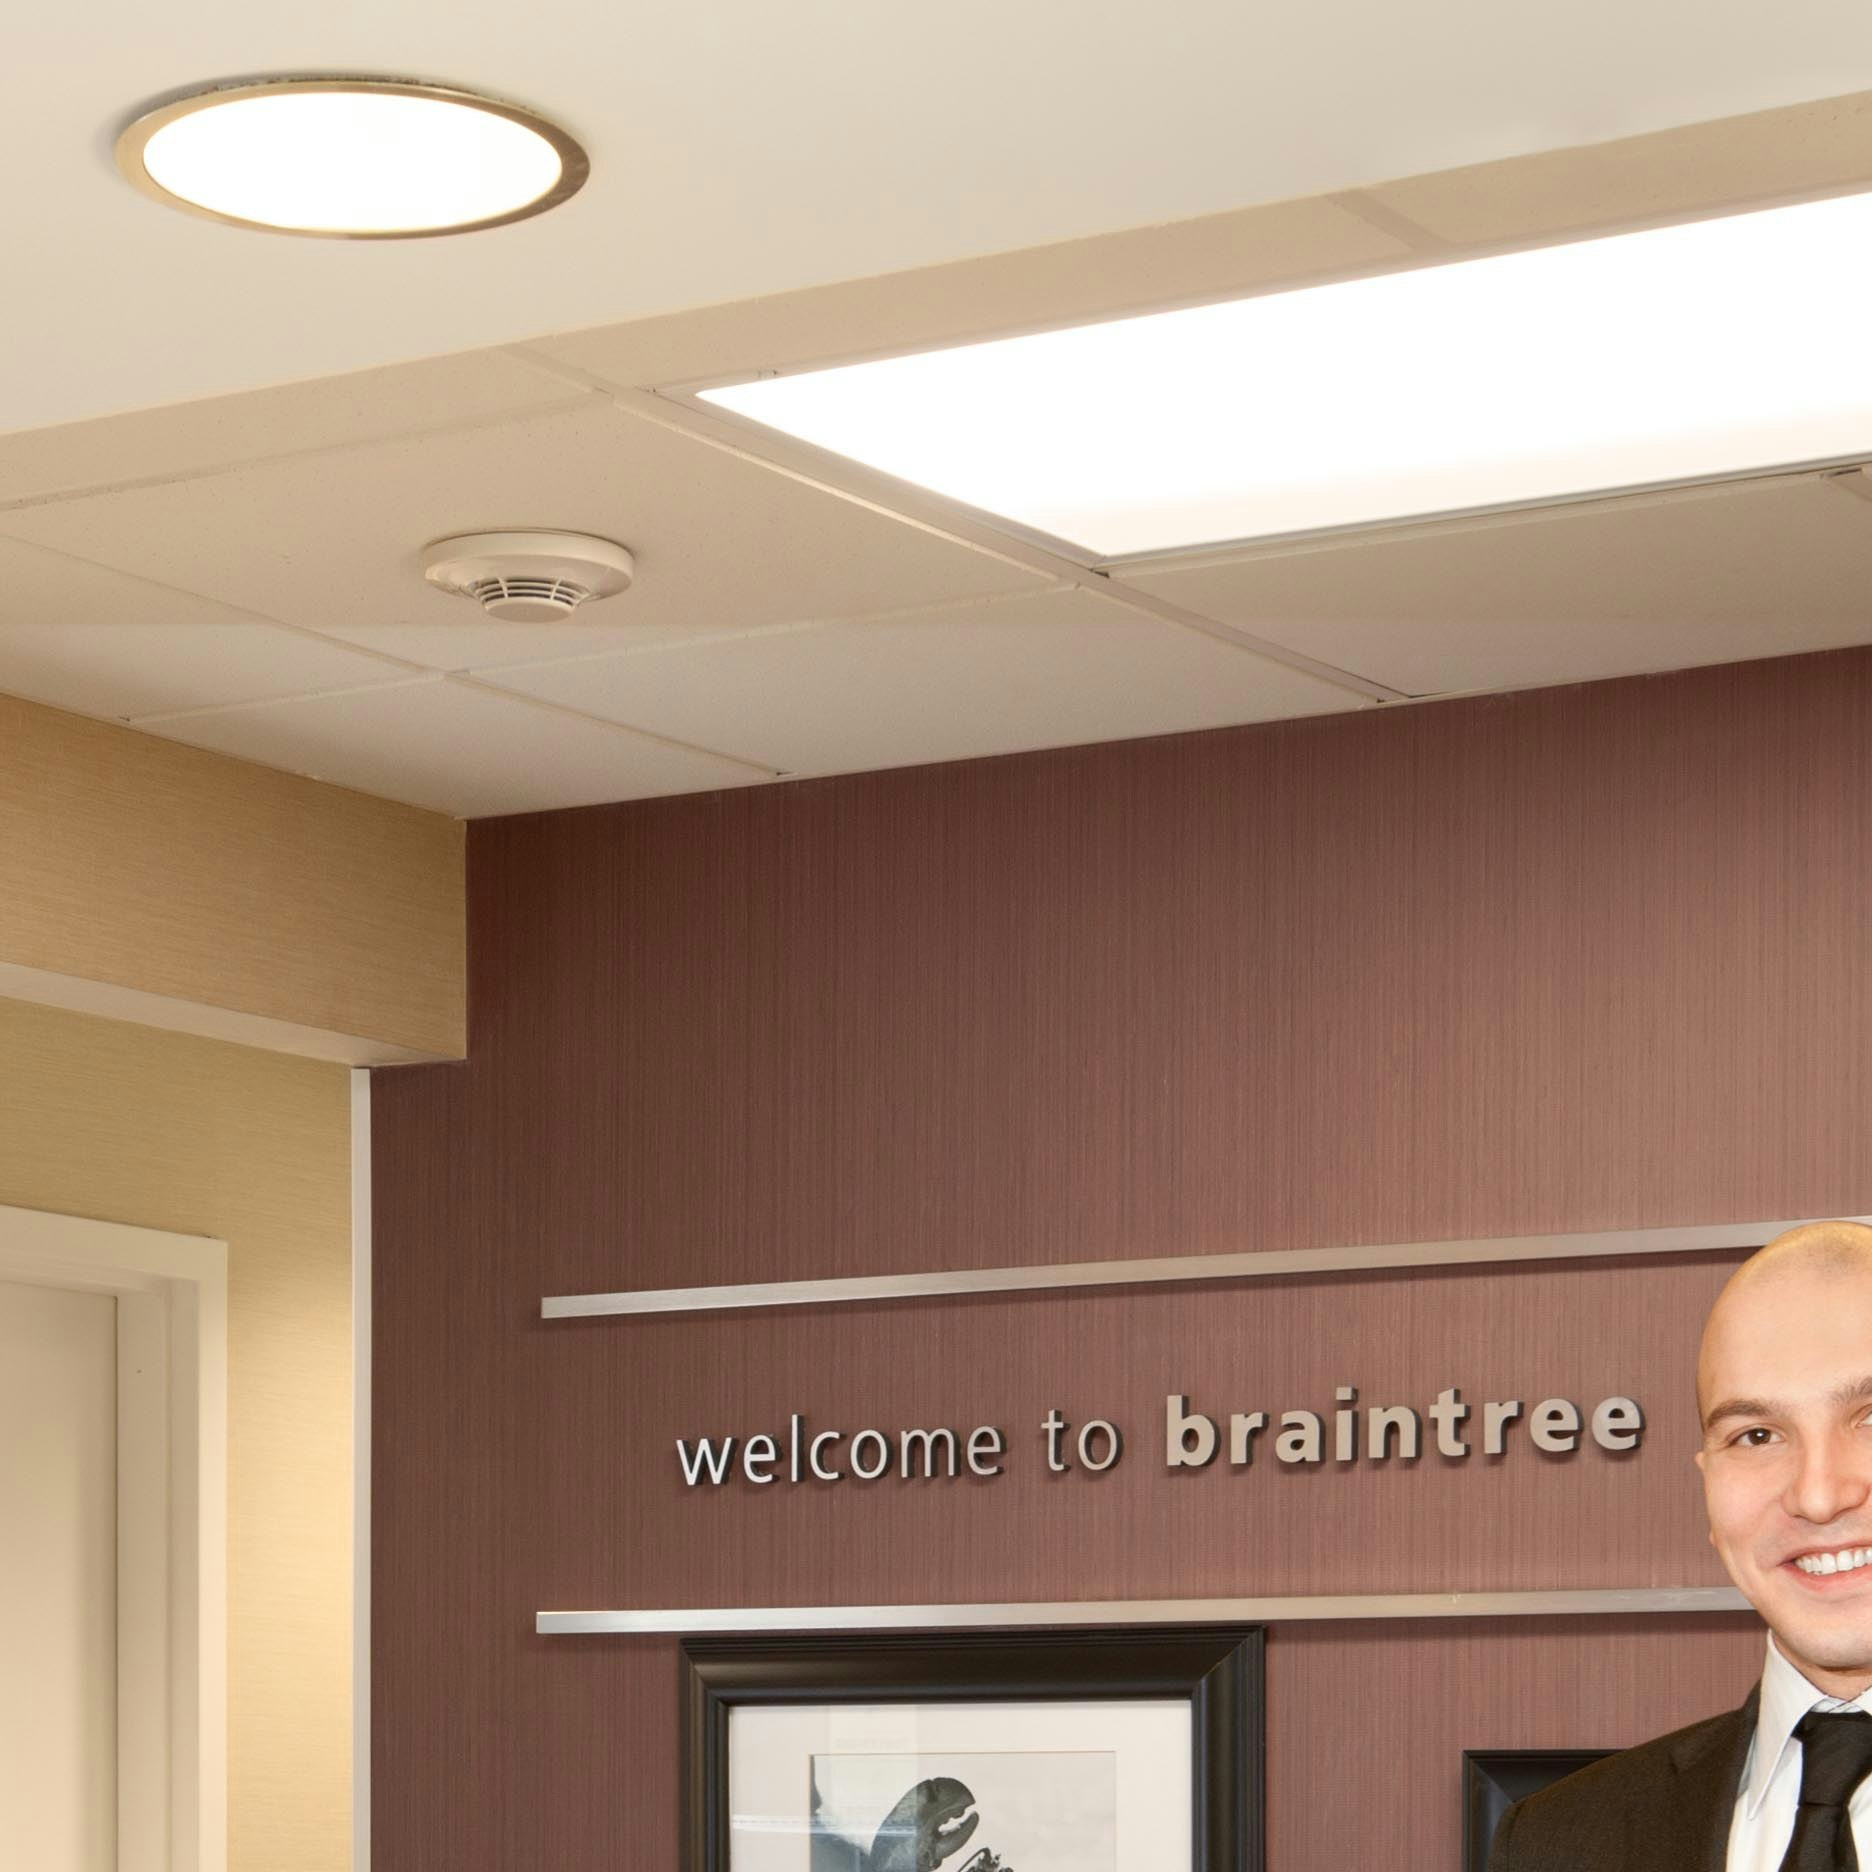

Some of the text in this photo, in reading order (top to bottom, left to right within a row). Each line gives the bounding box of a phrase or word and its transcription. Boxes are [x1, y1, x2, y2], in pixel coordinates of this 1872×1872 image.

[675, 1387, 1646, 1486] welcome to braintree
